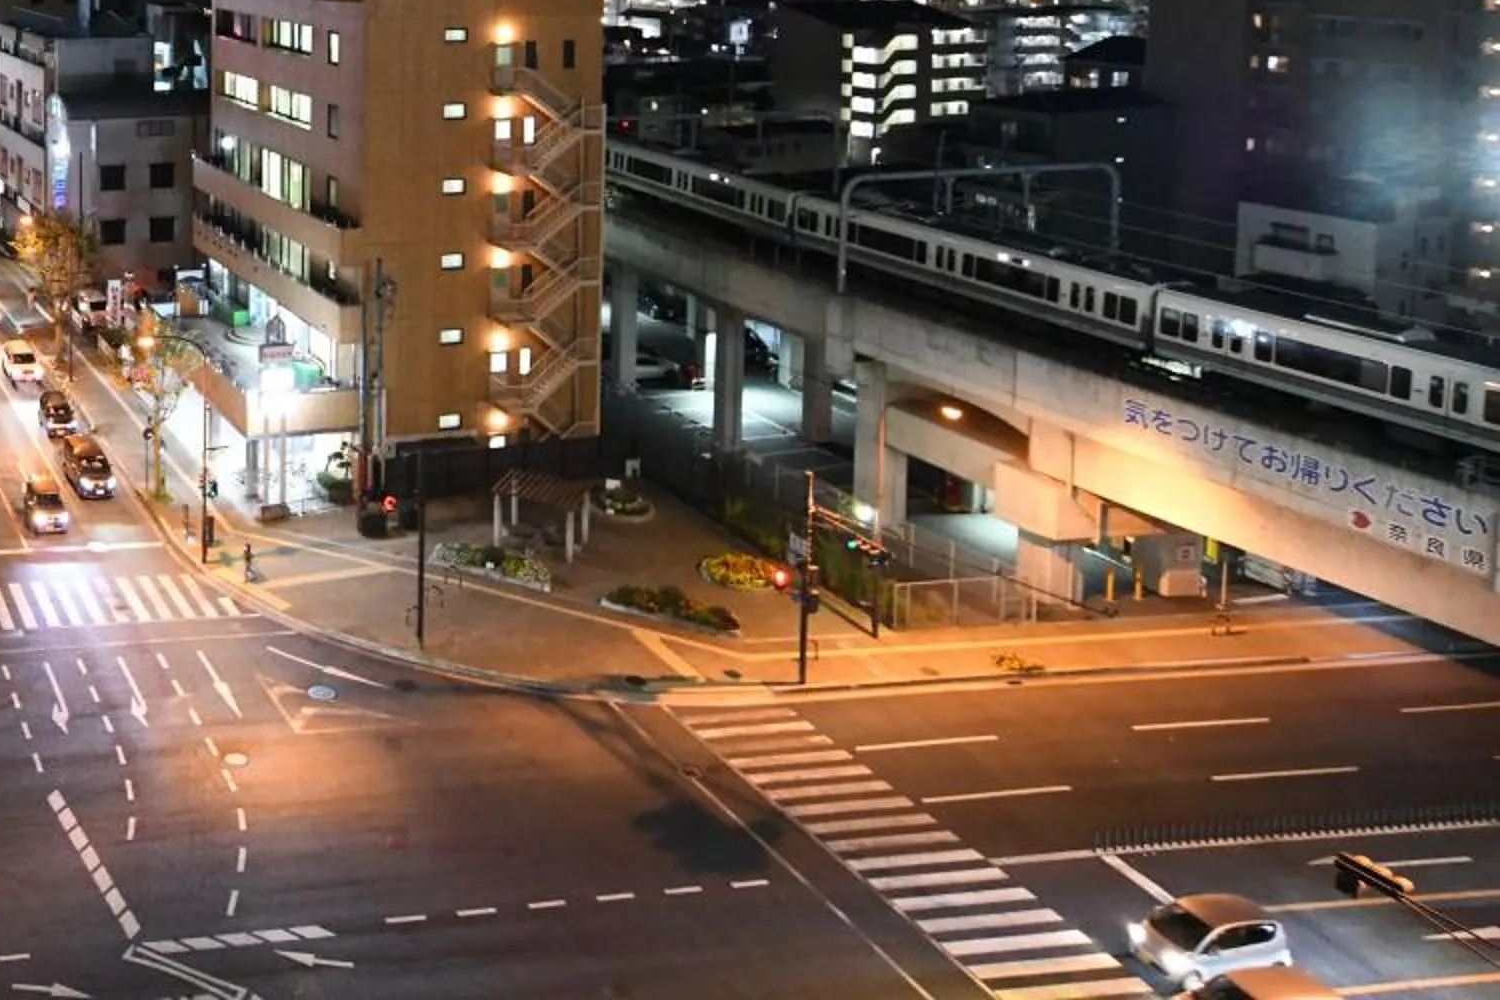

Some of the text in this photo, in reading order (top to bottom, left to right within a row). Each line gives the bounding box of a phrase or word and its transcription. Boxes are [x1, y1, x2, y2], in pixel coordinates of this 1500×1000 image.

[1124, 399, 1488, 534] 気をつけてお帰りください
[1388, 522, 1486, 571] 奈良県
